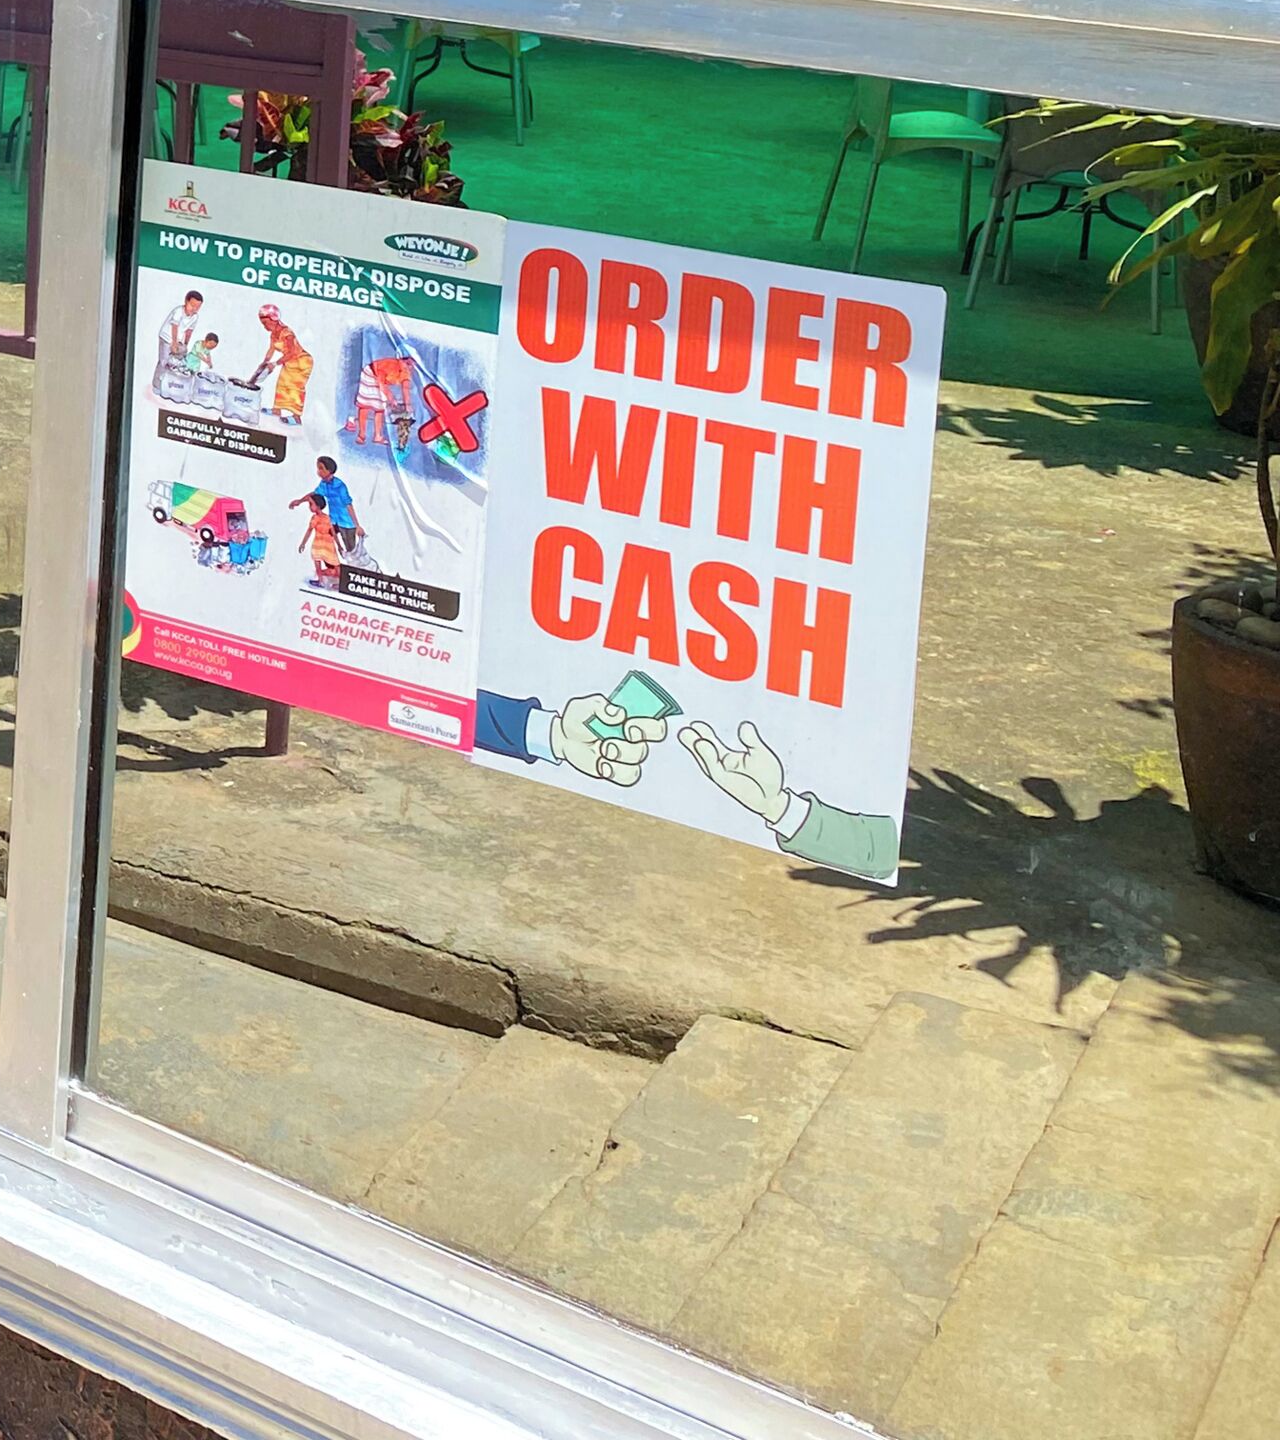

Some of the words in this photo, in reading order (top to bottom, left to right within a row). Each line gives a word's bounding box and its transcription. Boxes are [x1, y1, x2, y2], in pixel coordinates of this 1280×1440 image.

[168, 197, 208, 215] KCCA
[160, 231, 209, 254] HOW
[214, 240, 243, 260] TO
[249, 246, 364, 282] PROPERLY
[370, 269, 471, 304] DISPOSE
[242, 266, 271, 286] OF
[276, 273, 384, 308] GARBAGE
[515, 247, 912, 428] ORDER
[166, 416, 221, 434] CAREFULLY
[223, 428, 250, 441] SORT
[166, 426, 212, 443] GARBAGE
[213, 436, 228, 447] AT
[228, 440, 276, 458] DISPOSAL
[541, 386, 862, 565] WITH
[347, 583, 397, 603] GARBAGE
[399, 595, 436, 613] TRUCK
[348, 572, 377, 587] TAKE
[378, 580, 389, 590] IT
[390, 583, 405, 594] TO
[407, 587, 429, 601] THE
[301, 601, 312, 612] A
[316, 604, 435, 645] GARBAGE-FREE
[530, 525, 851, 709] CASH
[153, 638, 181, 654] 0800
[185, 647, 227, 667] 299000
[154, 626, 170, 638] Call
[171, 631, 197, 645] KCCA
[198, 638, 220, 651] TOLL
[222, 645, 247, 659] FREE
[248, 653, 287, 671] HOTLINE
[299, 628, 350, 651] PRIDE!
[301, 615, 395, 648] COMMUNITY
[398, 640, 413, 653] IS
[417, 645, 452, 664] OUR
